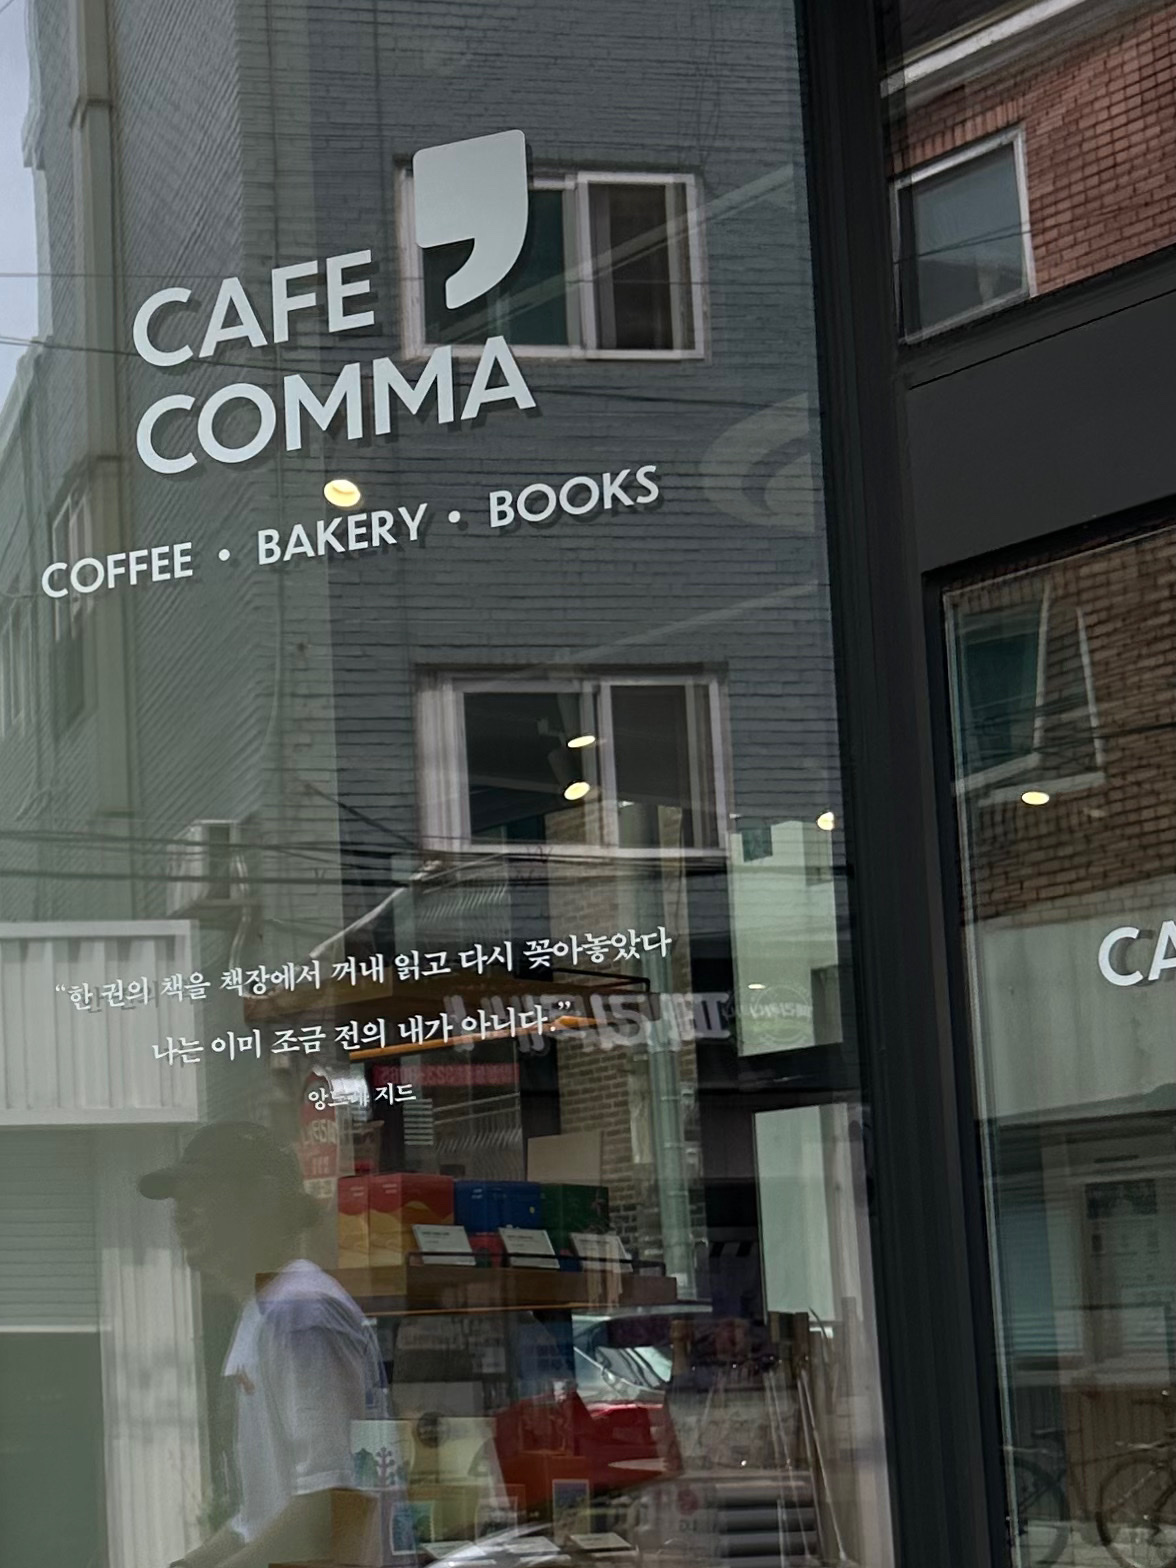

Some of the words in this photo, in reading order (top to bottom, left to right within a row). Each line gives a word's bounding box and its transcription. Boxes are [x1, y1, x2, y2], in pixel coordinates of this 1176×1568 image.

[132, 249, 375, 367] CAFE
[136, 335, 537, 475] COMMA
[41, 542, 194, 599] COFFEE
[257, 503, 428, 565] BAKERY
[488, 465, 660, 529] BOOKS
[101, 976, 149, 1007] 권의
[160, 971, 211, 1002] 책을
[219, 959, 321, 997] 책장에서
[330, 953, 385, 986] 꺼내
[394, 950, 452, 981] 읽고
[457, 940, 513, 975] 다시
[523, 925, 673, 970] 꽂아놓았다
[152, 1036, 204, 1066] 나는
[211, 1028, 262, 1061] 이미
[271, 1025, 326, 1055] 조금
[334, 1017, 387, 1050] 전의
[397, 1012, 454, 1045] 내가
[375, 1082, 417, 1105] 지드
